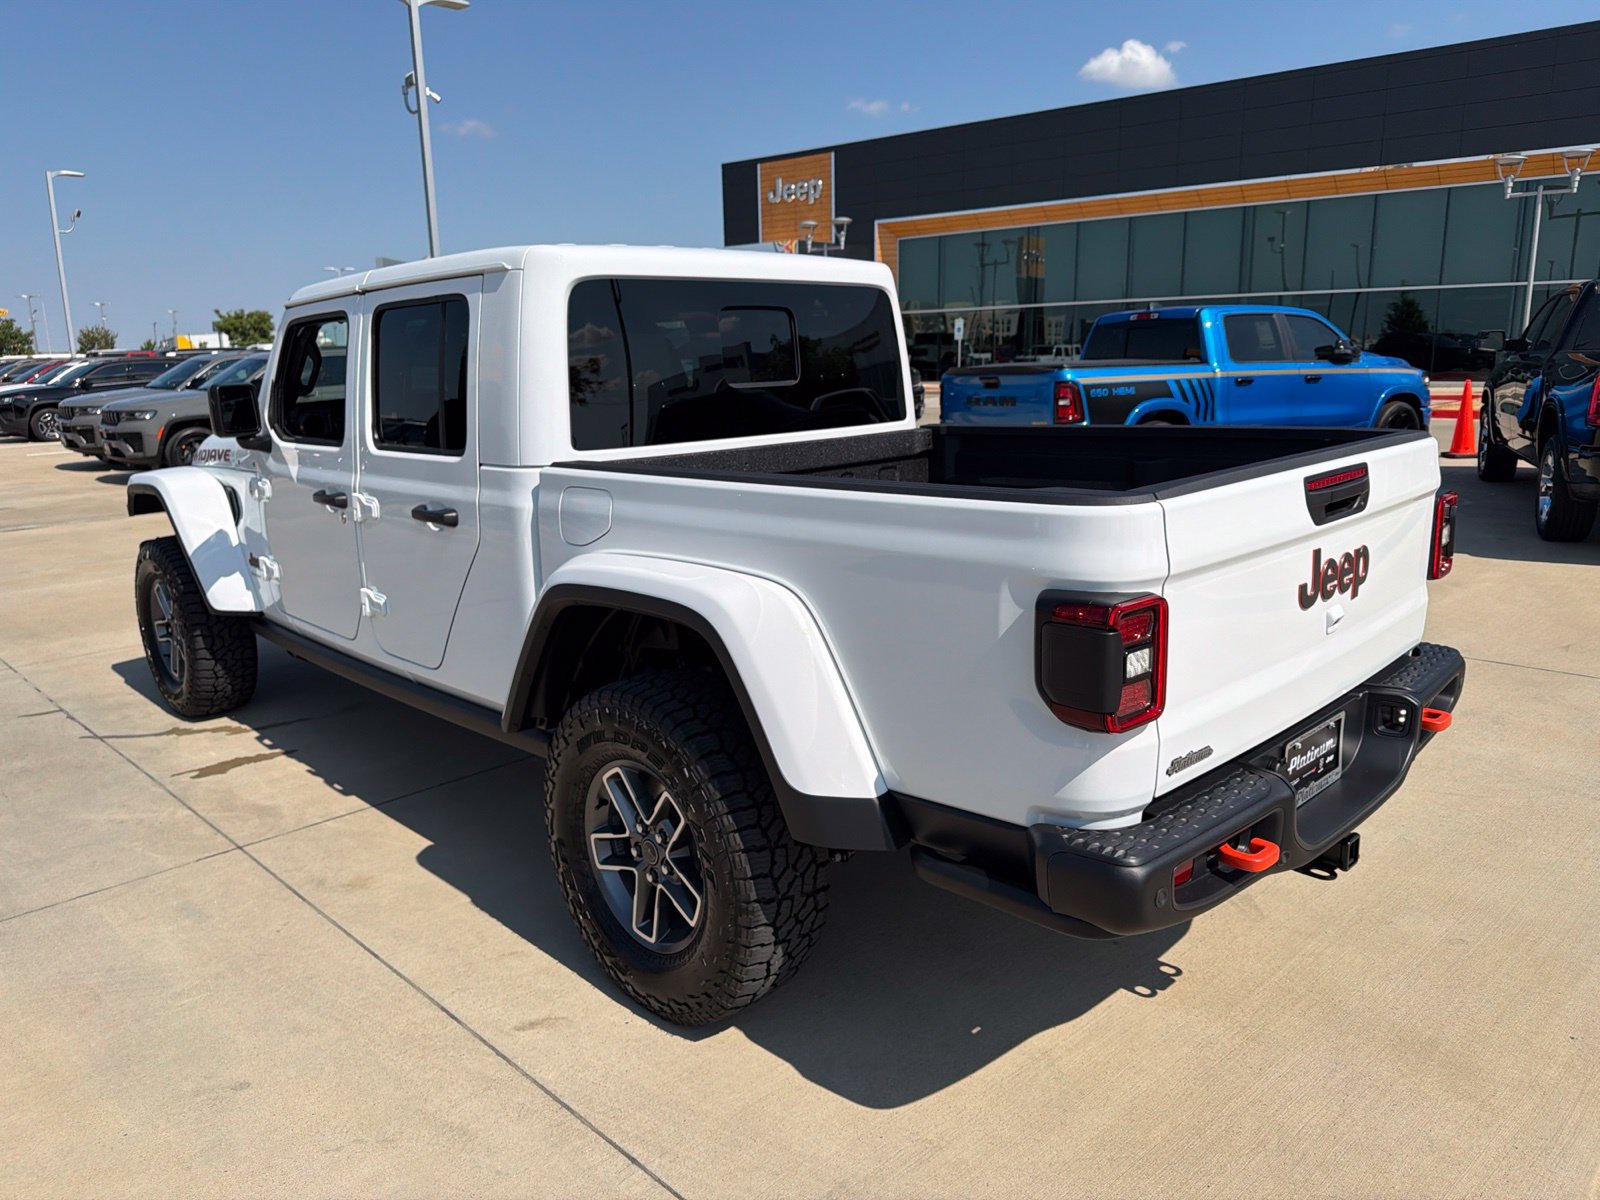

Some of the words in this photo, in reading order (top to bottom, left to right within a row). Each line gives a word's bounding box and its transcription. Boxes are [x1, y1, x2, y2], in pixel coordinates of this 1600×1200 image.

[767, 176, 823, 205] Jeep
[966, 395, 1017, 407] RAM
[1112, 386, 1136, 396] HEMI
[194, 449, 231, 463] MOJAVE
[1298, 544, 1370, 611] Jeep
[1287, 738, 1337, 775] Platinum
